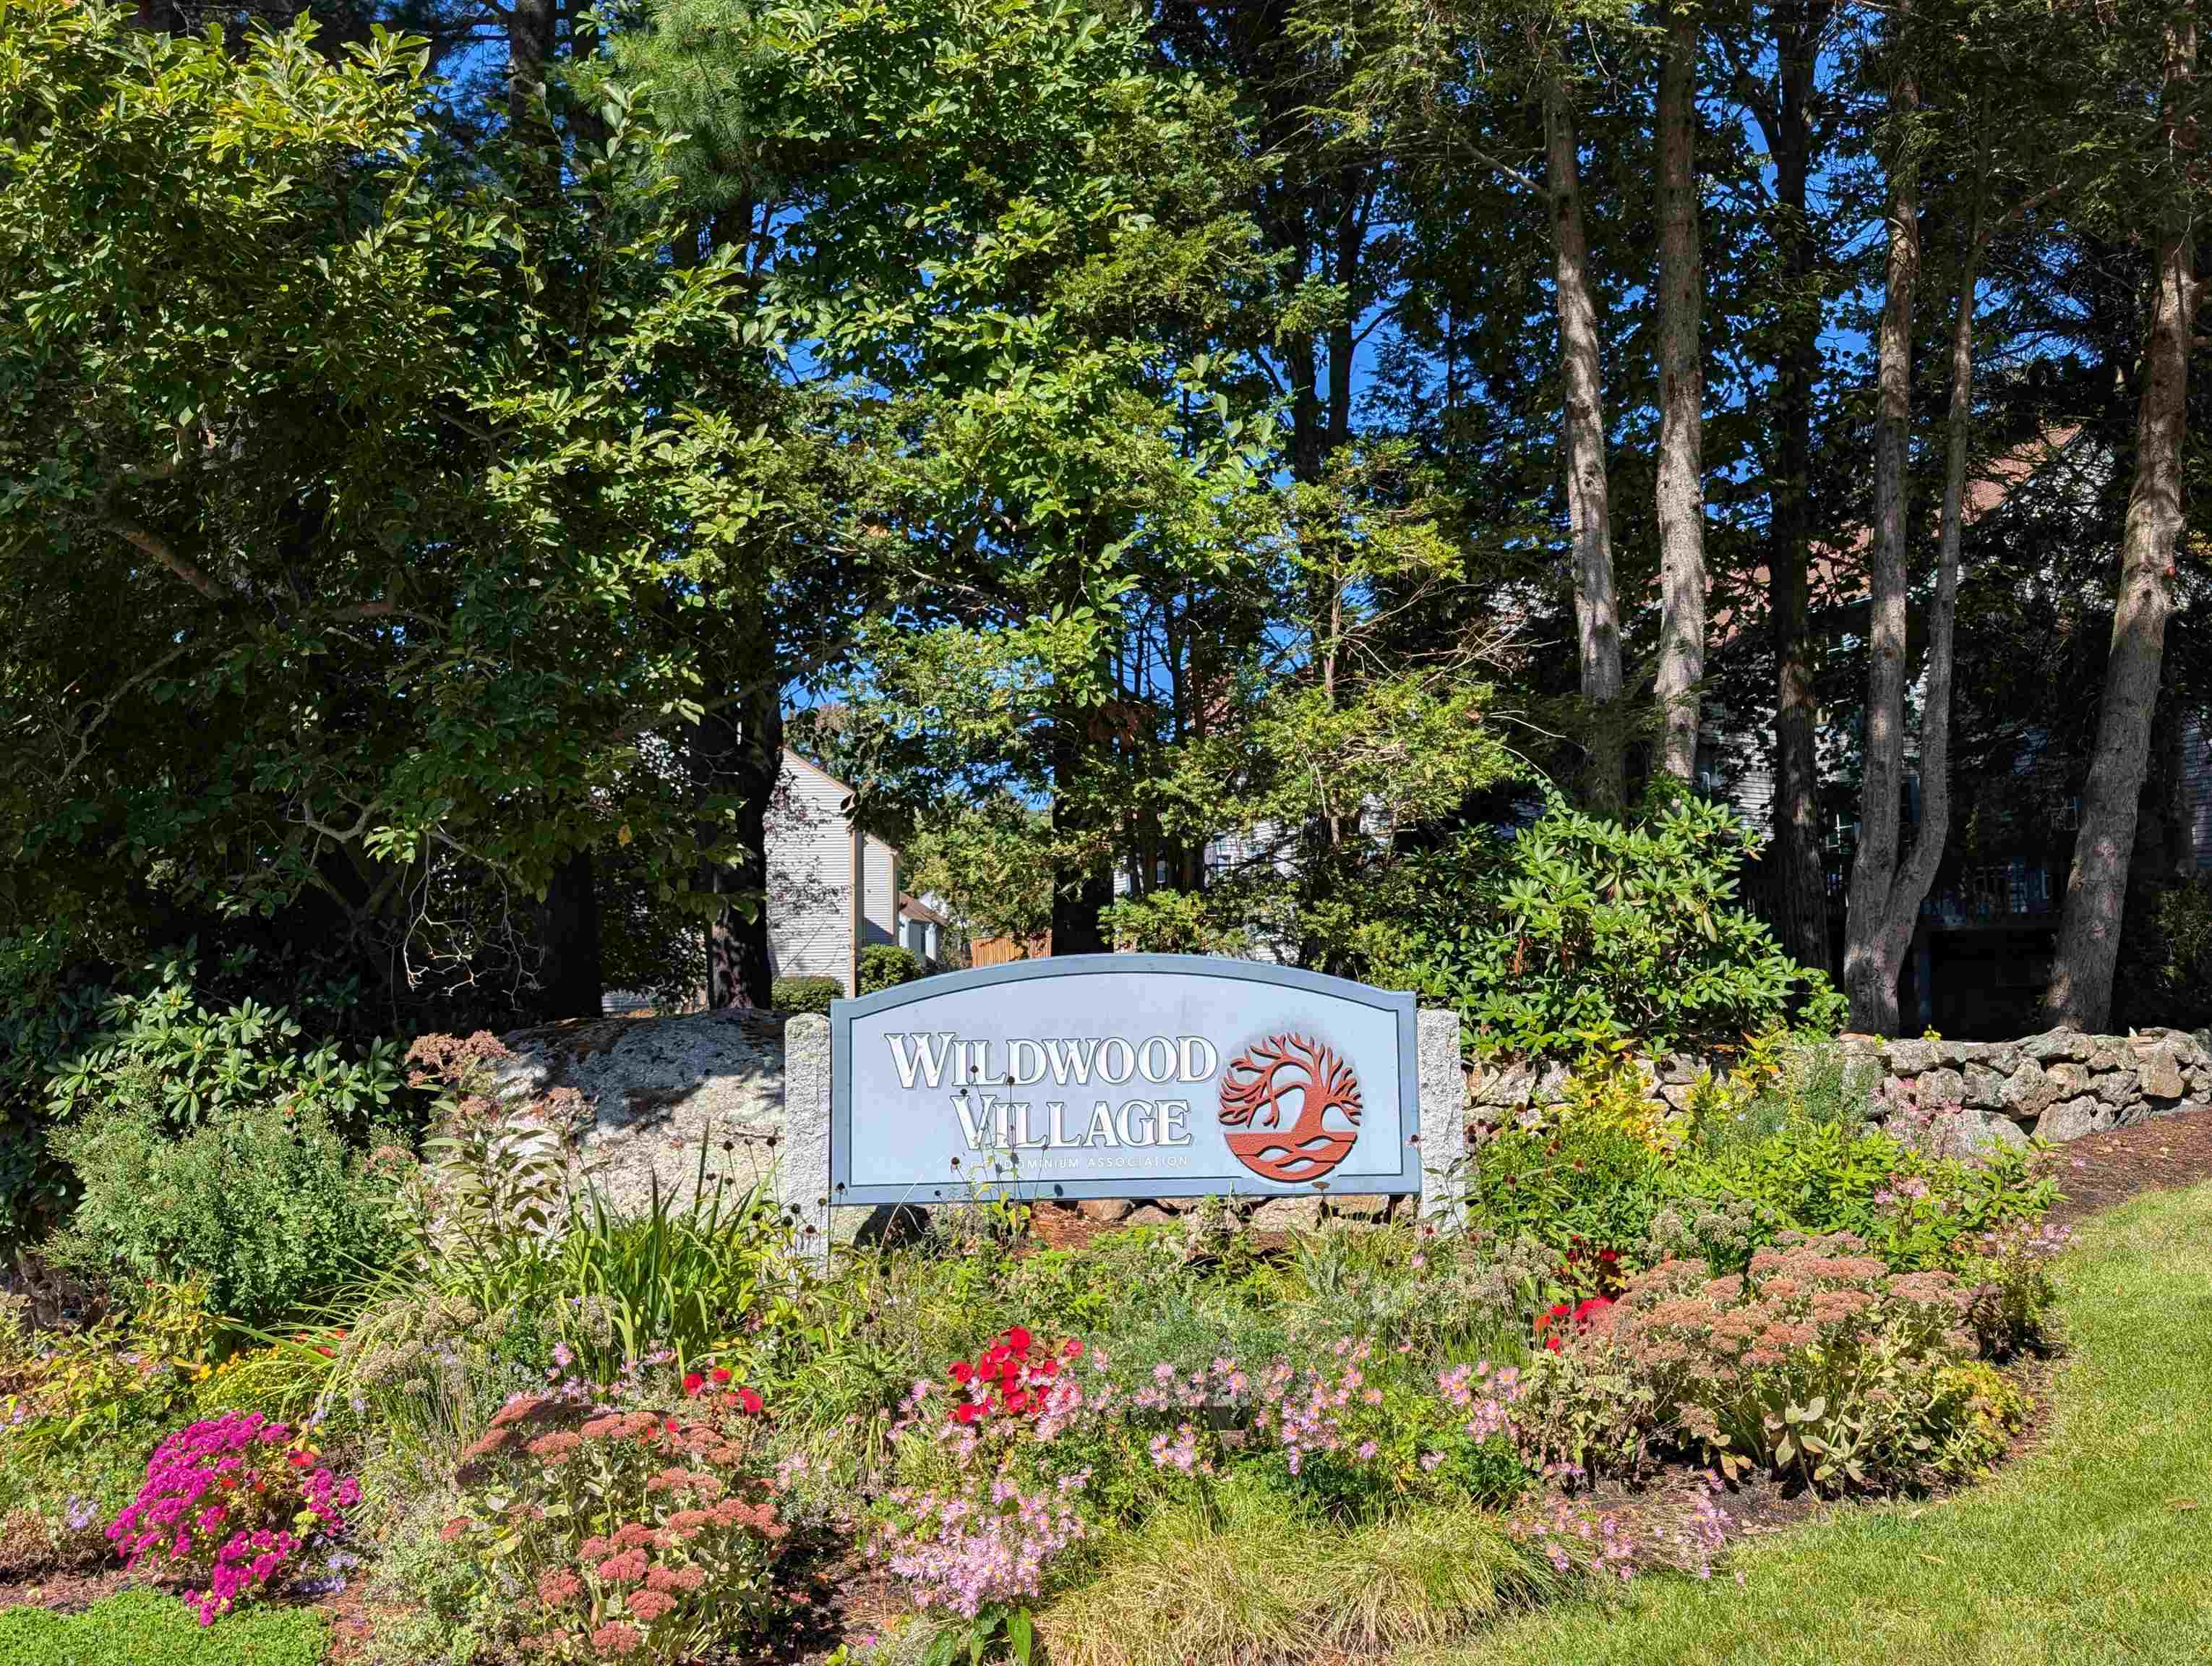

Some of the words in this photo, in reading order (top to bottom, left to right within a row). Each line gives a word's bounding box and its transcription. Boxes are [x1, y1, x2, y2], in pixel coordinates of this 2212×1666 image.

[884, 1032, 1219, 1088] WILDWOOD
[950, 1094, 1192, 1150] VILLAGE
[970, 1157, 1079, 1169] DOMINIUM
